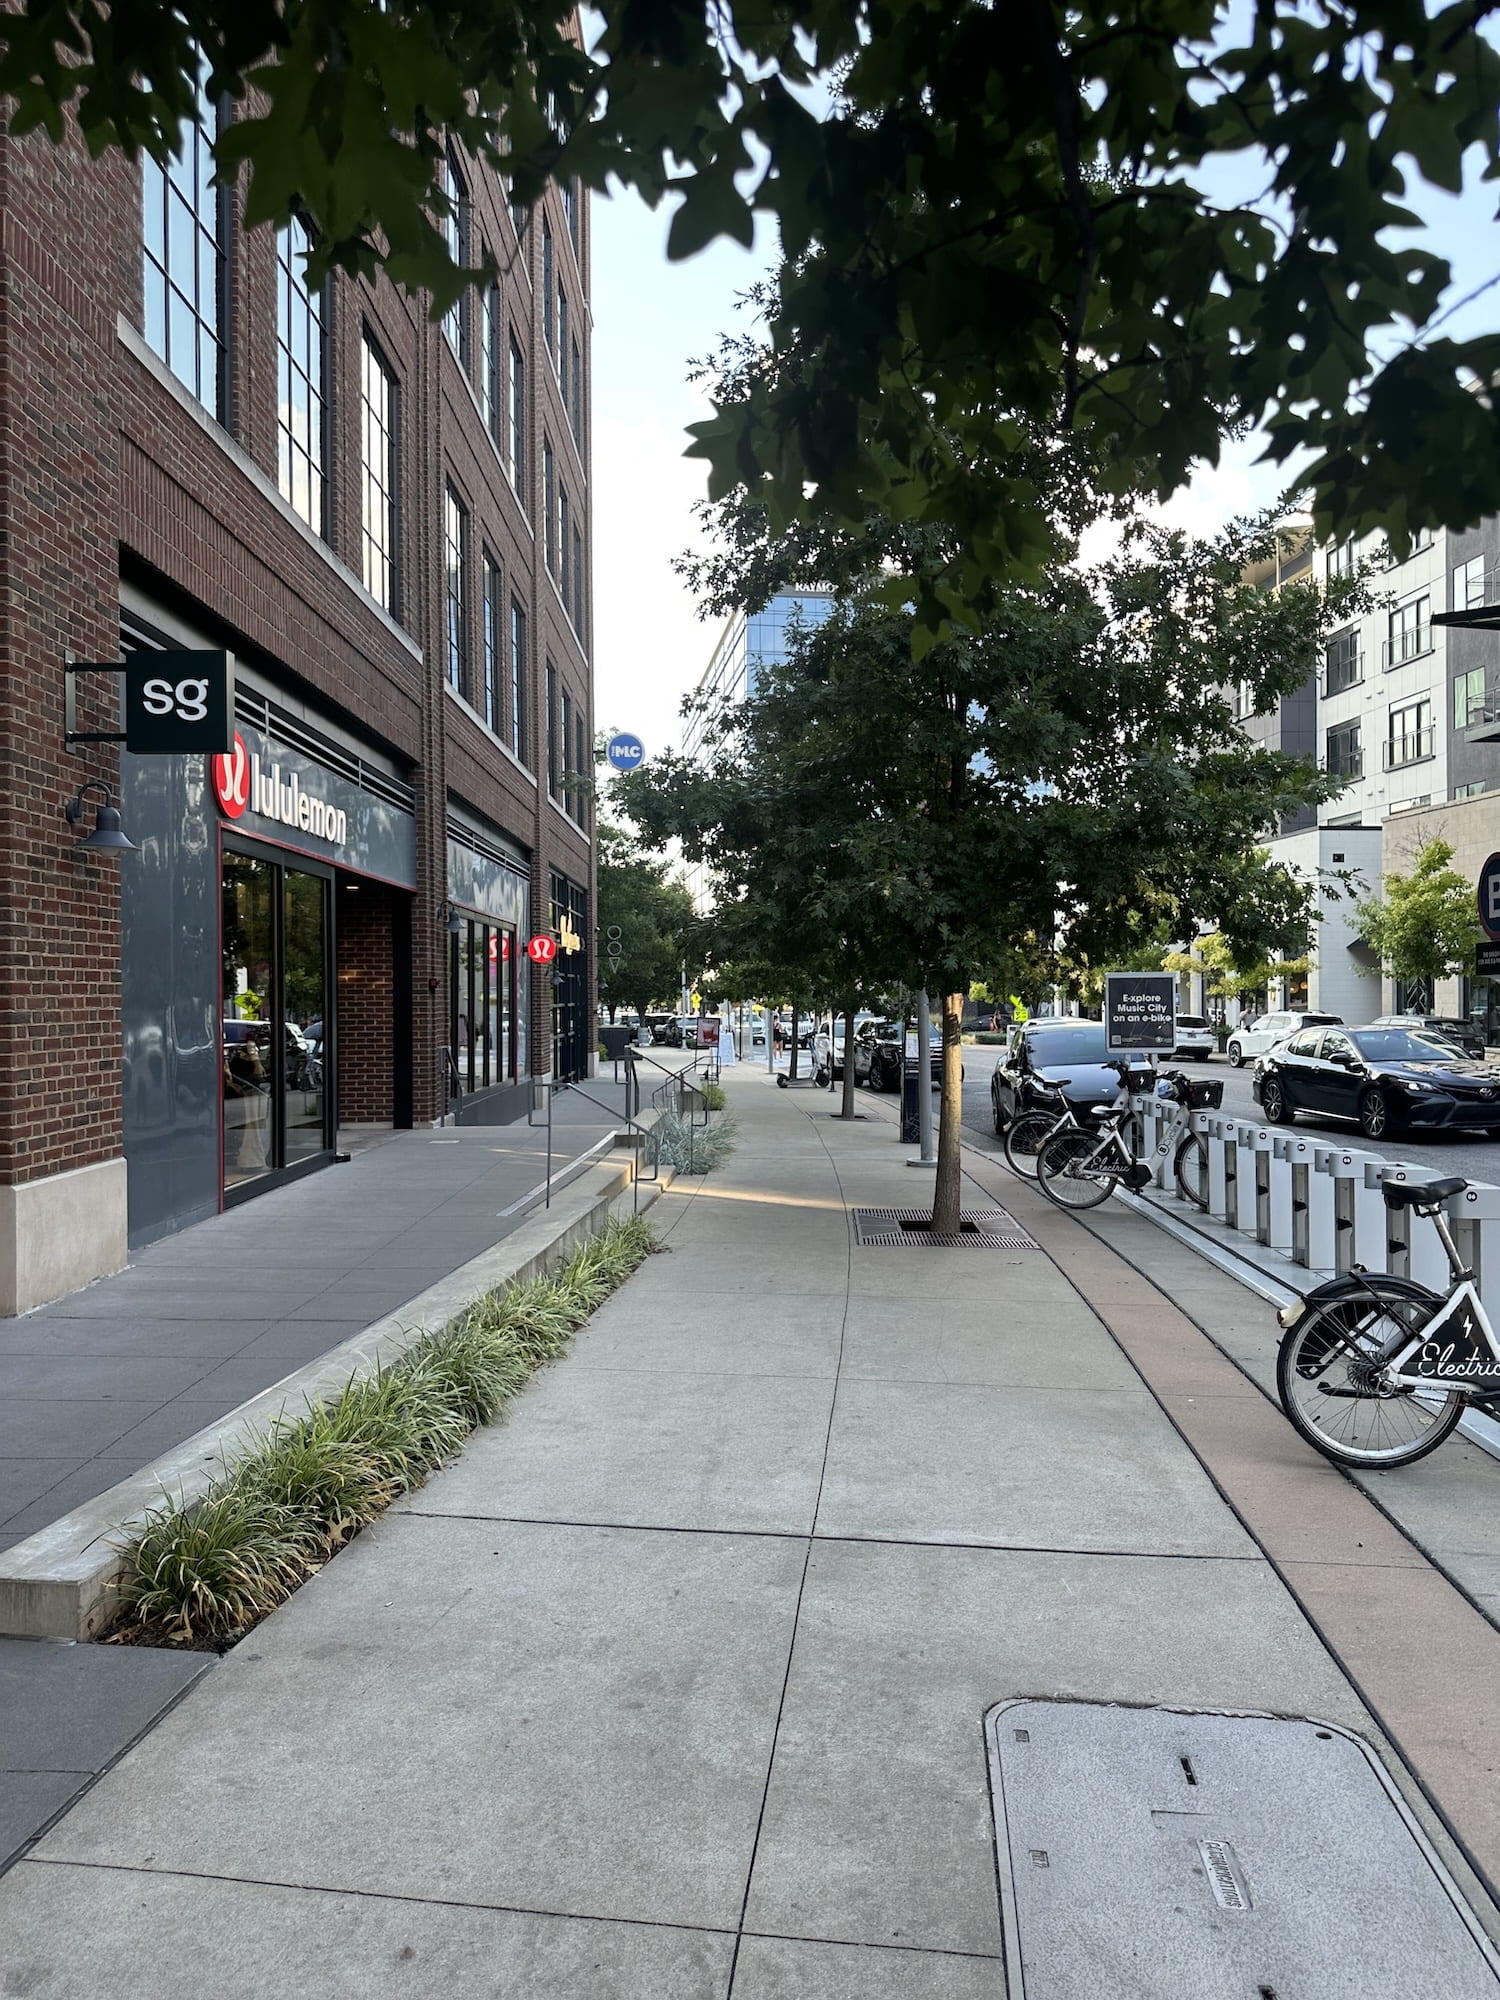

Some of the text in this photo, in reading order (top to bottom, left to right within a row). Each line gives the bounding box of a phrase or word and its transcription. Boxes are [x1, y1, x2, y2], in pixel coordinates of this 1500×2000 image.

[142, 678, 209, 721] sg
[616, 746, 640, 757] MLC
[250, 753, 347, 845] lululemon
[1123, 994, 1161, 1003] E-xplore
[1117, 1004, 1167, 1013] Music City
[1091, 1156, 1130, 1172] Electric
[1418, 1342, 1500, 1376] Electric
